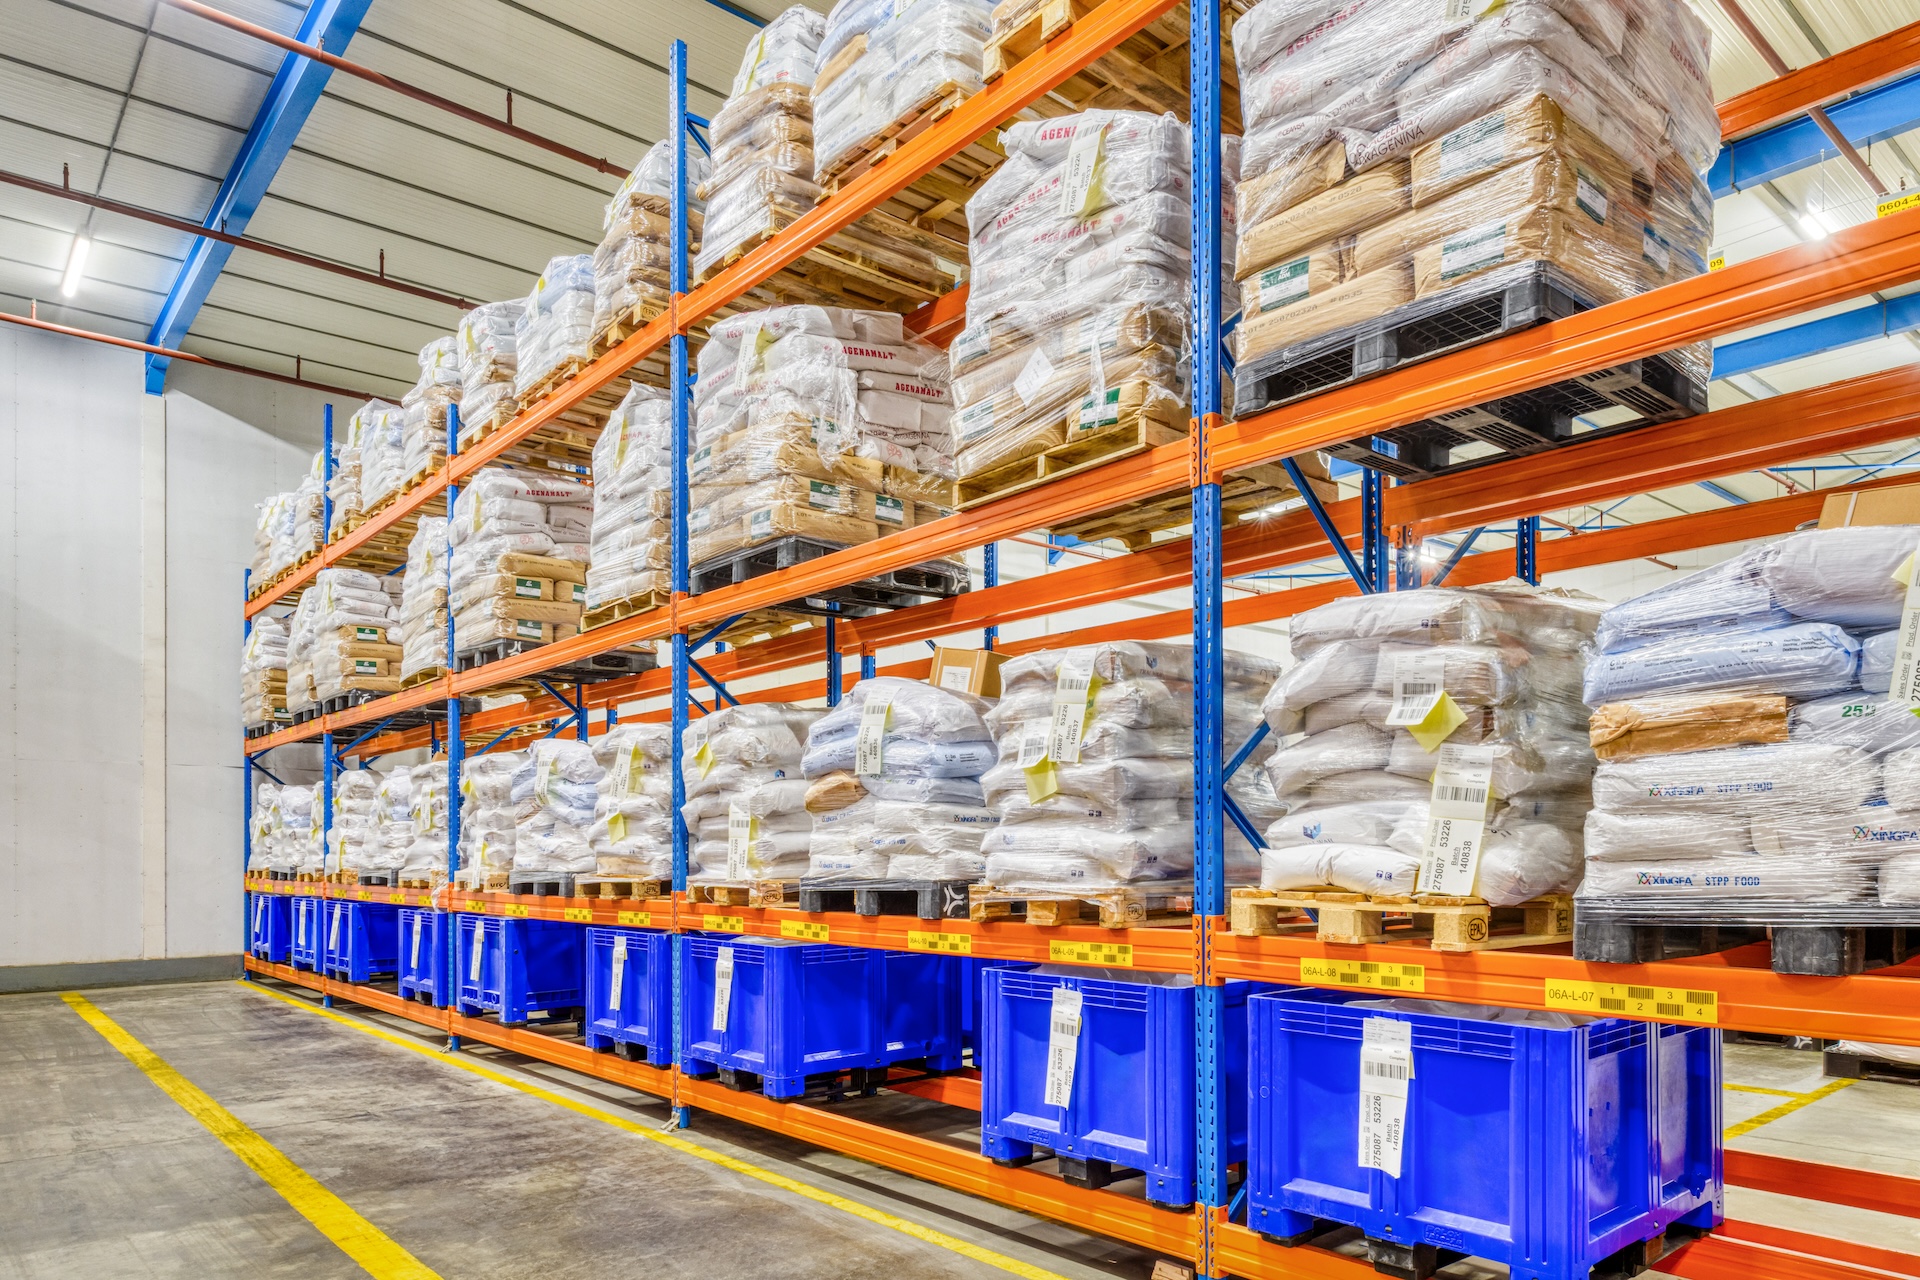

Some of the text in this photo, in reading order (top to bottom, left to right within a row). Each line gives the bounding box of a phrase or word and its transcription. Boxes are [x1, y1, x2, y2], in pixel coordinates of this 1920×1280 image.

[1268, 304, 1318, 326] 25070232A
[1906, 612, 1918, 647] Prod. Order
[1900, 664, 1908, 682] Order
[1060, 704, 1068, 726] 53226
[1842, 705, 1864, 718] 25
[1070, 720, 1079, 745] 140837
[1717, 784, 1742, 794] STPP
[1747, 782, 1773, 792] FOOD
[1440, 820, 1452, 848] 53226
[1451, 846, 1461, 866] Batch
[1460, 840, 1472, 874] 140838
[1432, 857, 1446, 891] 275087
[1705, 876, 1730, 886] STPP
[1734, 876, 1760, 886] FOOD
[1470, 924, 1484, 936] EPAL
[1051, 947, 1074, 956] 06A-L-09
[1303, 966, 1336, 977] 06A-L-08
[1549, 988, 1594, 1002] 06A-L-07
[1667, 991, 1673, 1000] 3
[1637, 1002, 1643, 1011] 2
[1696, 1008, 1703, 1016] 4
